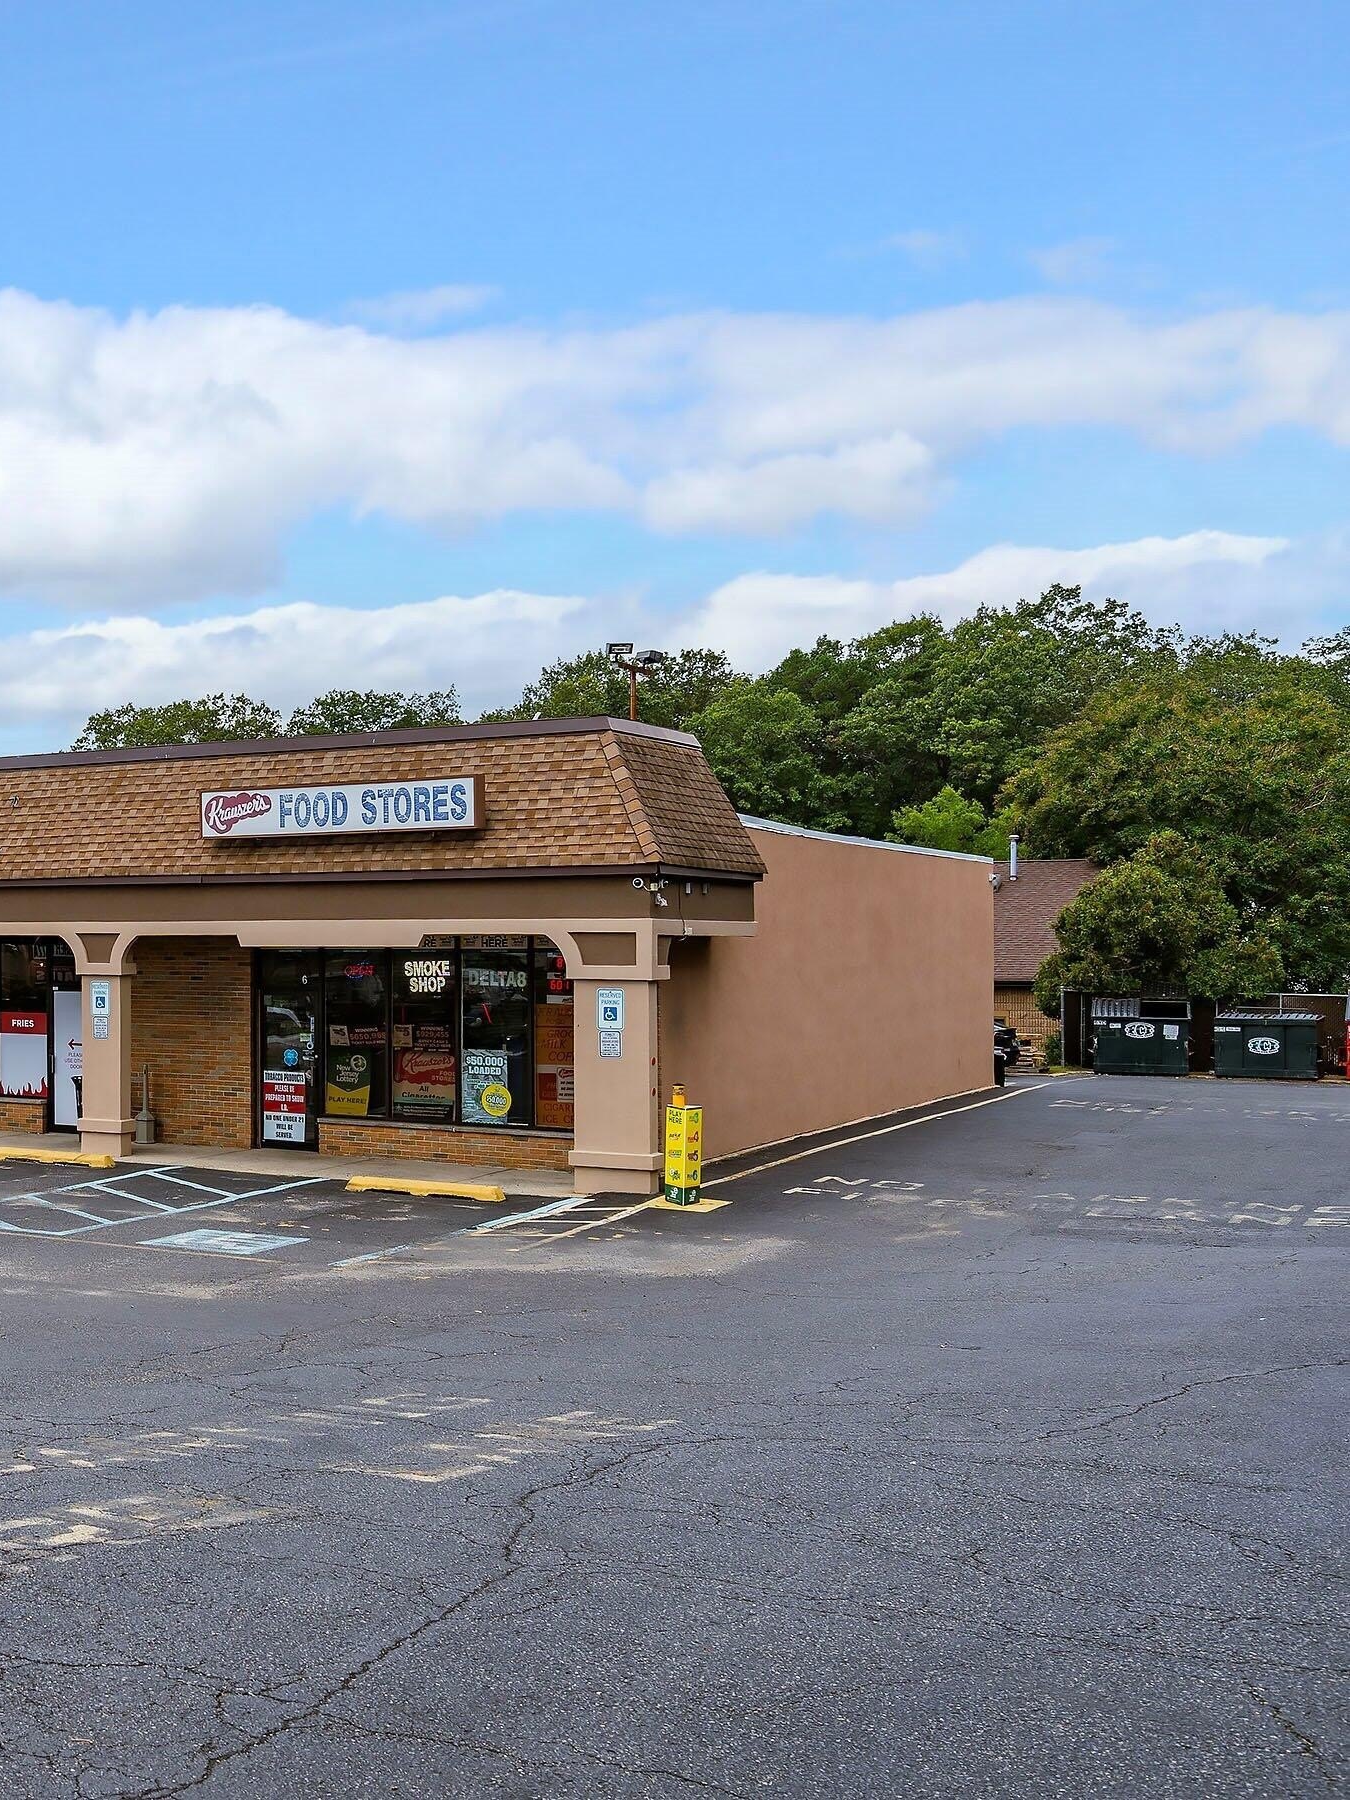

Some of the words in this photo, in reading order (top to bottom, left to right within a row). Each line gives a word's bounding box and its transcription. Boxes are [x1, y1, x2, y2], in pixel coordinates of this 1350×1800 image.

[207, 793, 271, 830] Krauszer's
[279, 791, 348, 828] FOOD
[361, 783, 468, 825] STORES
[480, 938, 509, 948] HERE
[404, 960, 451, 977] SMOKE
[301, 974, 308, 985] 6
[467, 969, 527, 988] DELTA8
[409, 976, 446, 993] SHOP
[11, 1019, 35, 1028] FRIES
[468, 1066, 502, 1075] LOADED
[668, 1109, 683, 1117] PLAY
[668, 1116, 683, 1125] HERE
